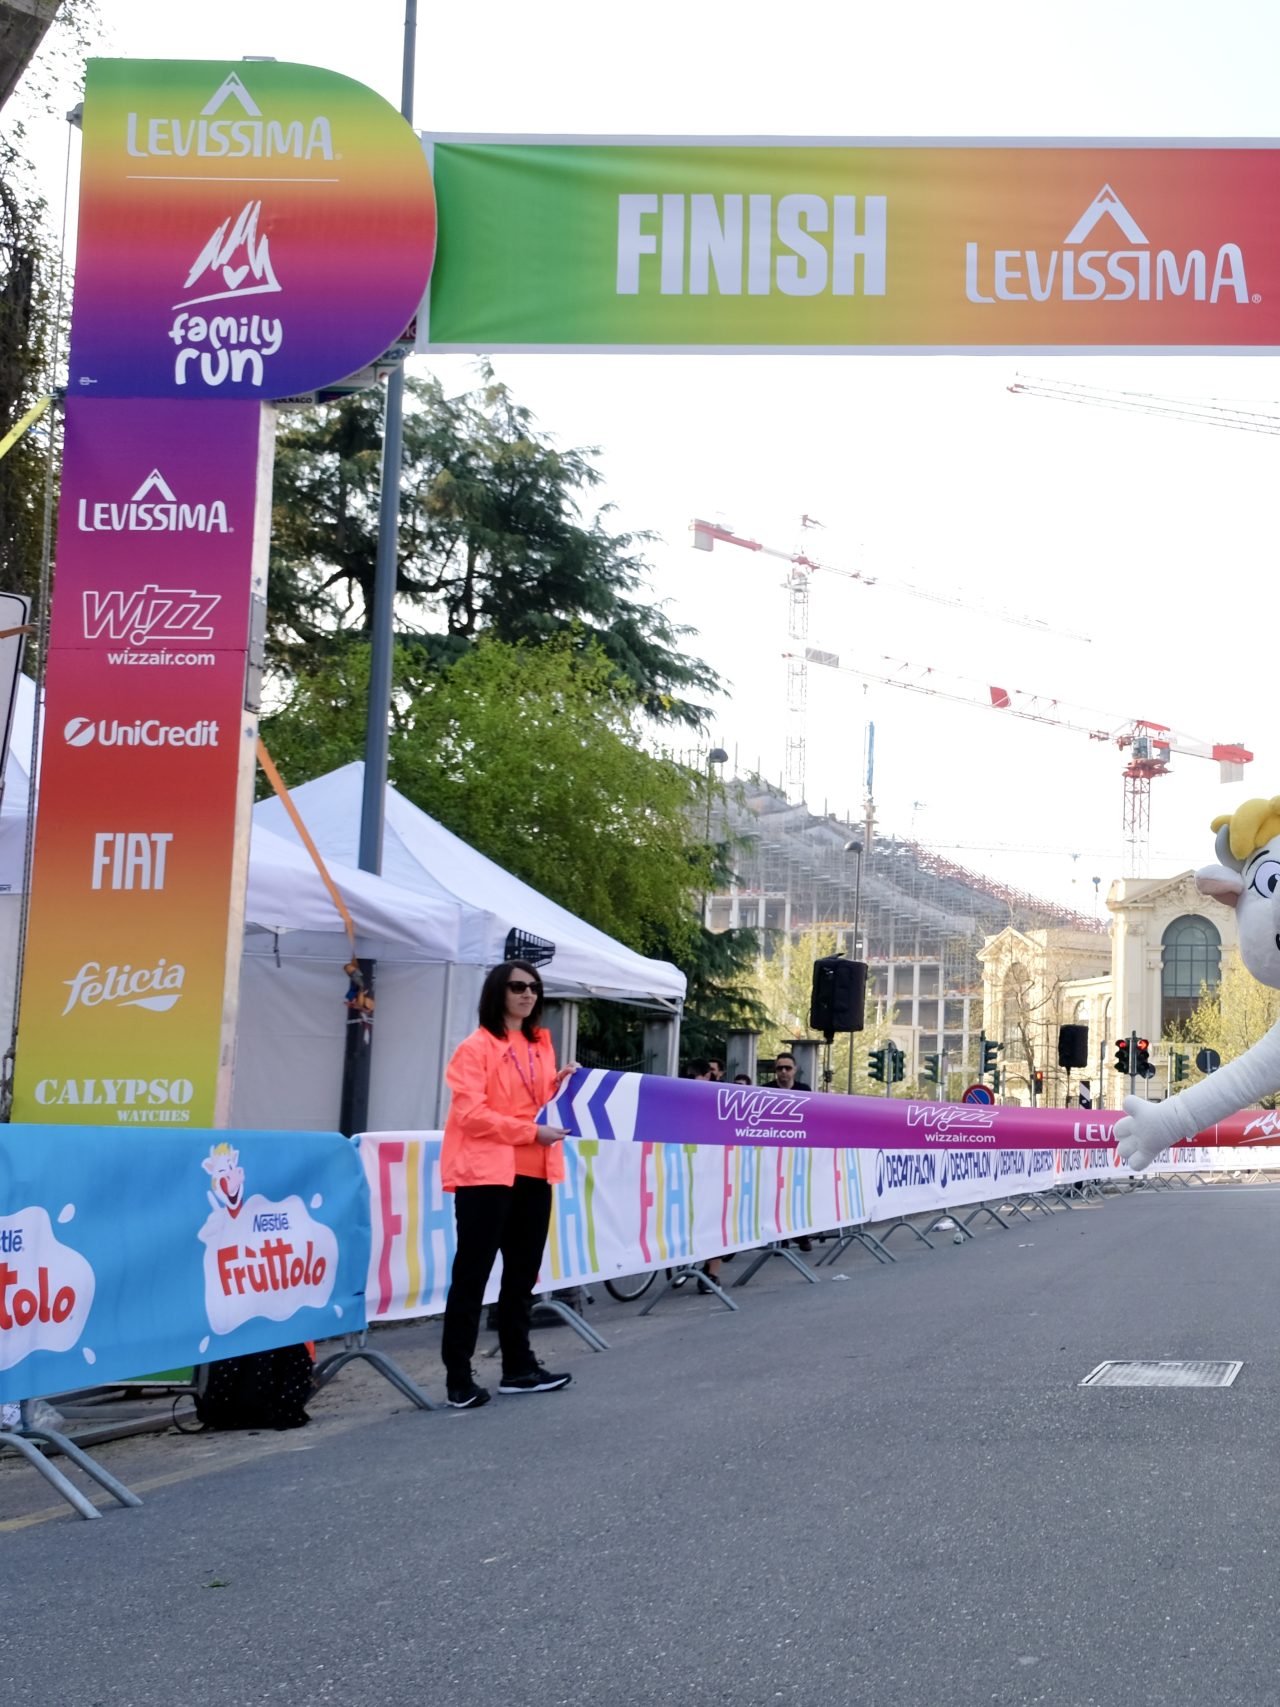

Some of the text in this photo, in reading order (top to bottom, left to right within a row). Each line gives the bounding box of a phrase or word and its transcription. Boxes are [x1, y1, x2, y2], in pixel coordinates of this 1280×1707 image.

[126, 113, 335, 161] LEVISSIMA
[616, 193, 888, 296] FINISH
[965, 242, 1251, 304] LEVISSIMA
[168, 312, 283, 356] family
[174, 347, 264, 387] run
[78, 498, 229, 534] LEVISSIMA
[107, 646, 216, 666] wizzair.com
[99, 719, 219, 747] UniCredit
[91, 832, 174, 891] FIAT
[62, 958, 186, 1017] felicia
[34, 1078, 194, 1106] CALYPSO
[116, 1109, 191, 1123] WATCHES
[734, 1126, 807, 1140] wizzair.com
[924, 1131, 996, 1144] wizzair.com
[885, 1153, 936, 1189] DECATHLON
[950, 1152, 991, 1182] DECATHLON
[536, 1140, 599, 1281] IAT
[639, 1141, 698, 1264] FIAT
[722, 1146, 764, 1248] FIAT
[376, 1141, 459, 1315] FIA
[217, 1238, 327, 1297] Frùttolo
[0, 1262, 76, 1331] tolo
